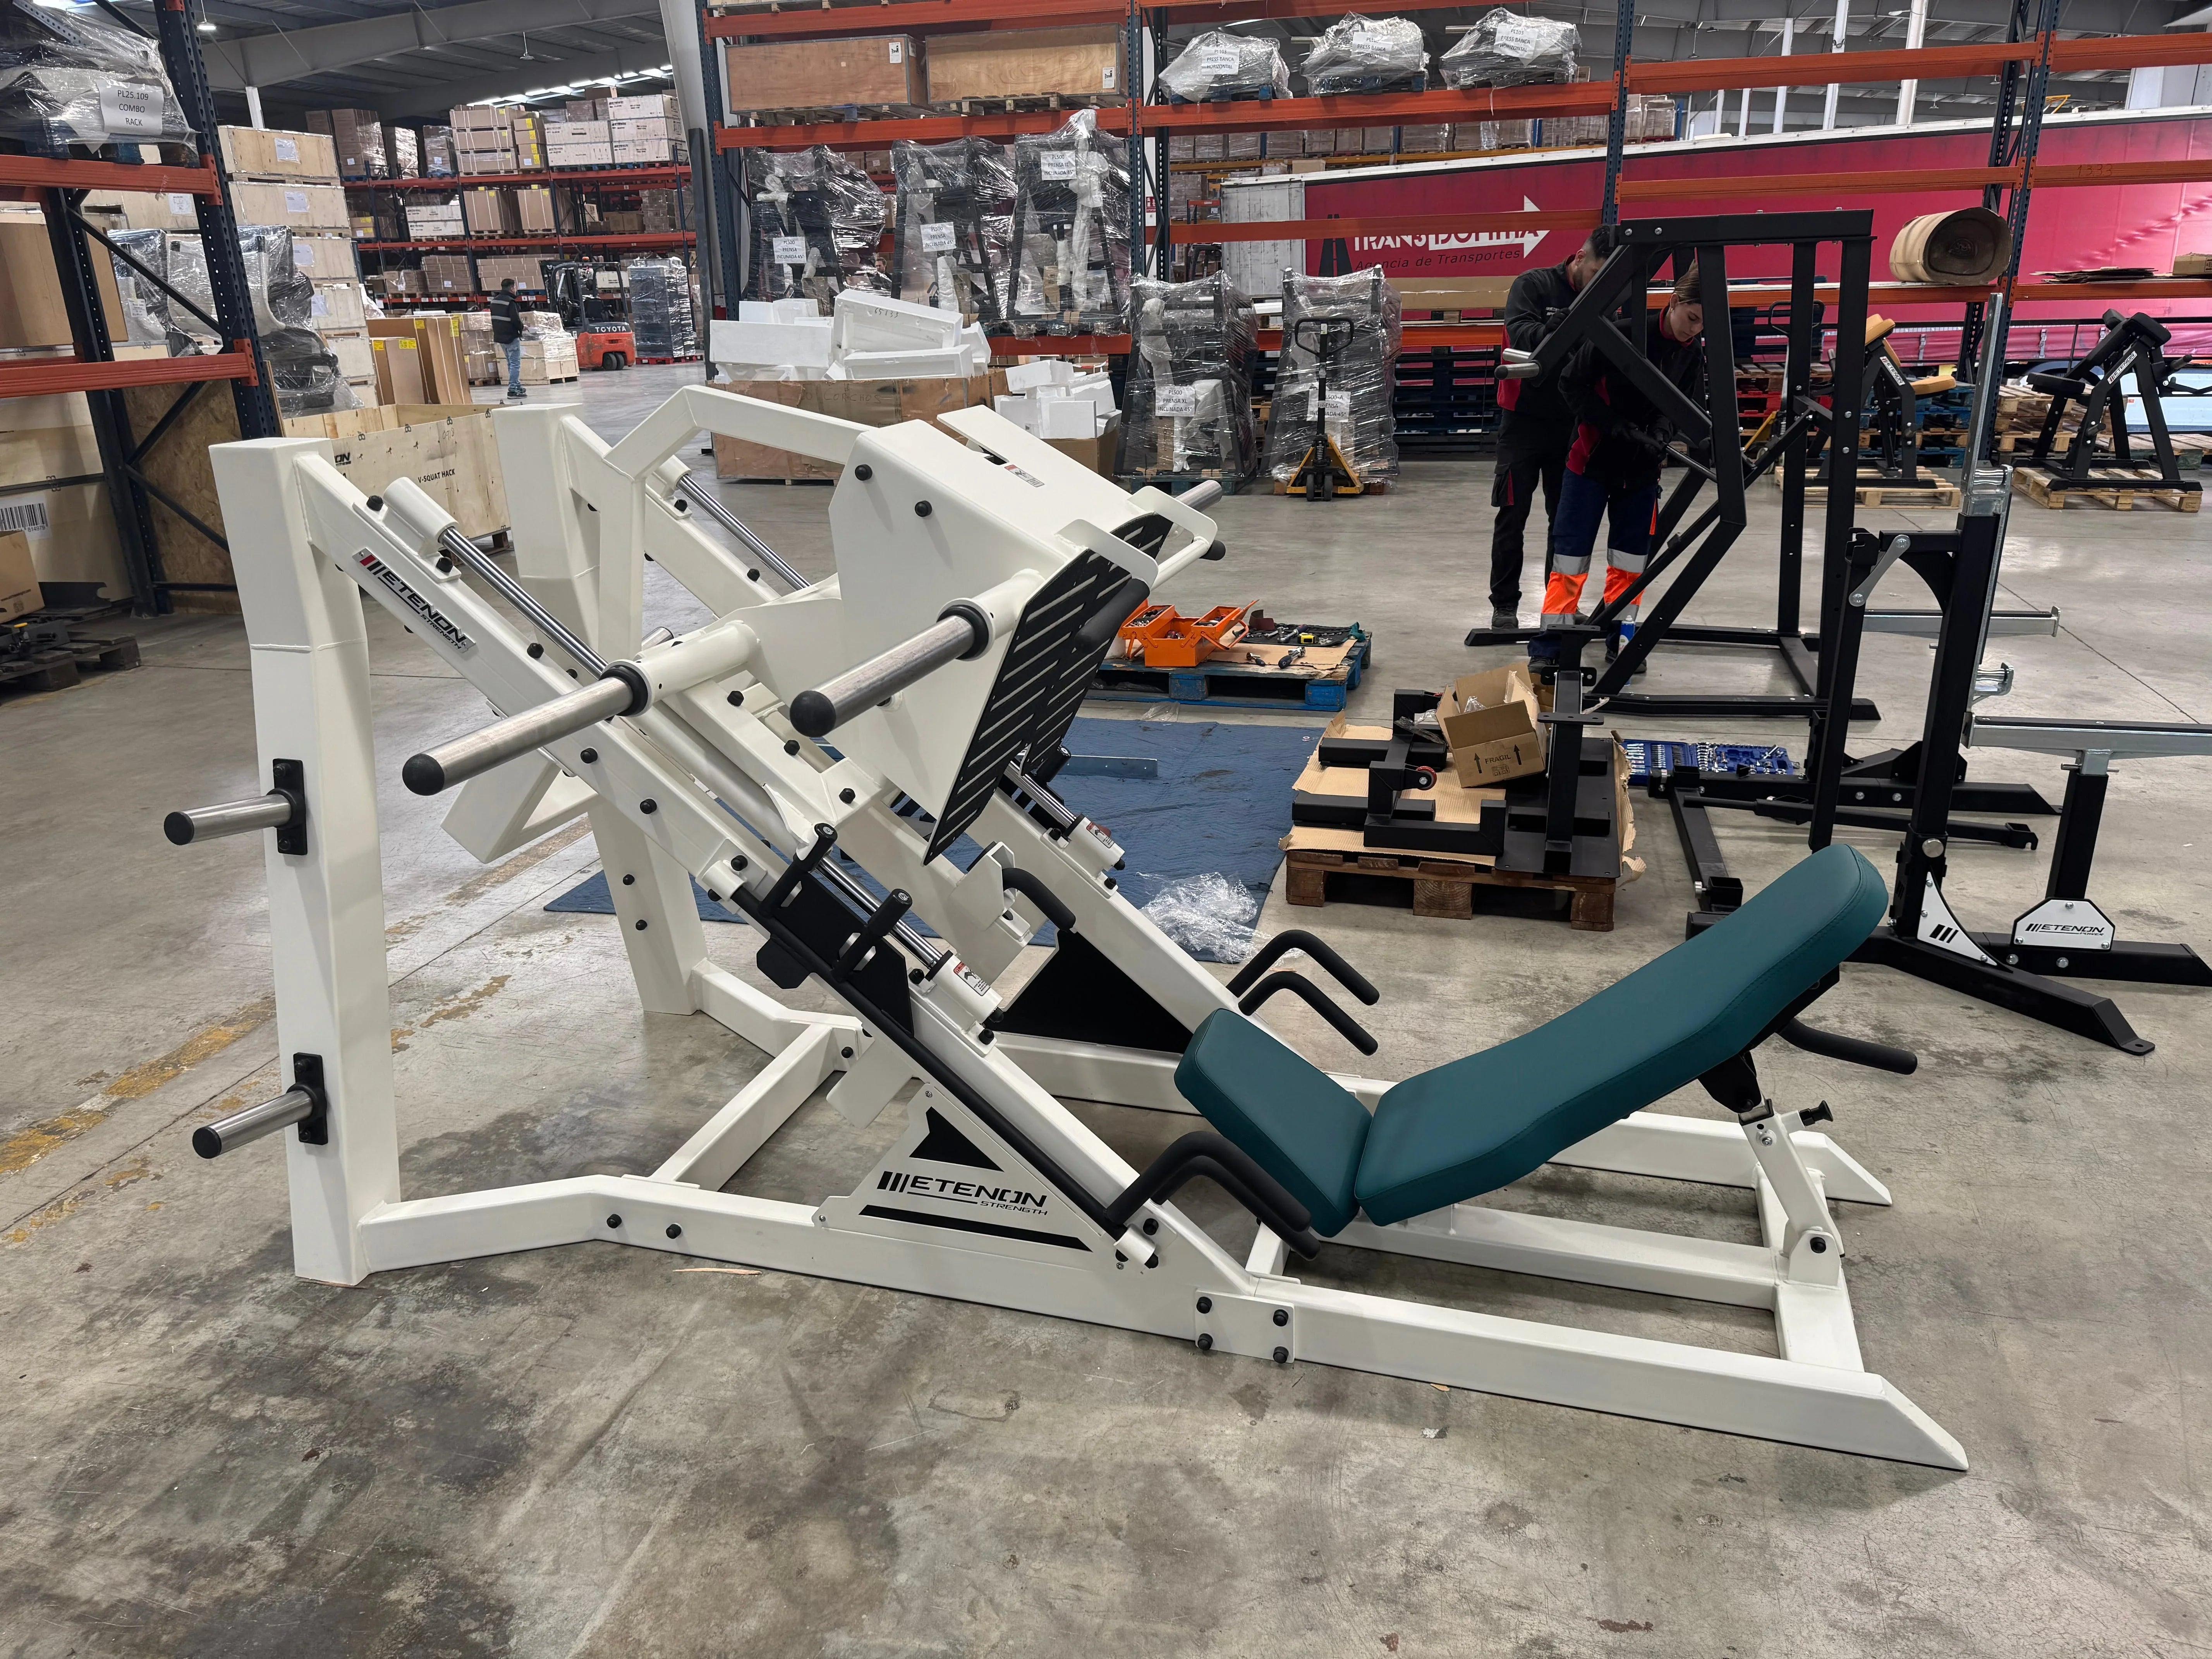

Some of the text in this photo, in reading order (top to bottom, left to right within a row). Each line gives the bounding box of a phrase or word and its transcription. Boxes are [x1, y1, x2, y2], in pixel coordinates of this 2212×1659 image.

[117, 89, 149, 100] PL25.109
[119, 103, 145, 113] COMBO
[125, 118, 143, 126] RACK
[1415, 256, 1432, 266] de
[1437, 250, 1521, 264] Transportes
[418, 468, 455, 483] V-SQUAT HACK
[382, 570, 467, 643] ETENON
[420, 614, 462, 649] STRENGTH
[1485, 754, 1511, 764] FRAGIL
[2041, 924, 2105, 933] ETENON
[910, 1175, 1048, 1207] ETENON
[980, 1200, 1048, 1216] STRENGTH
